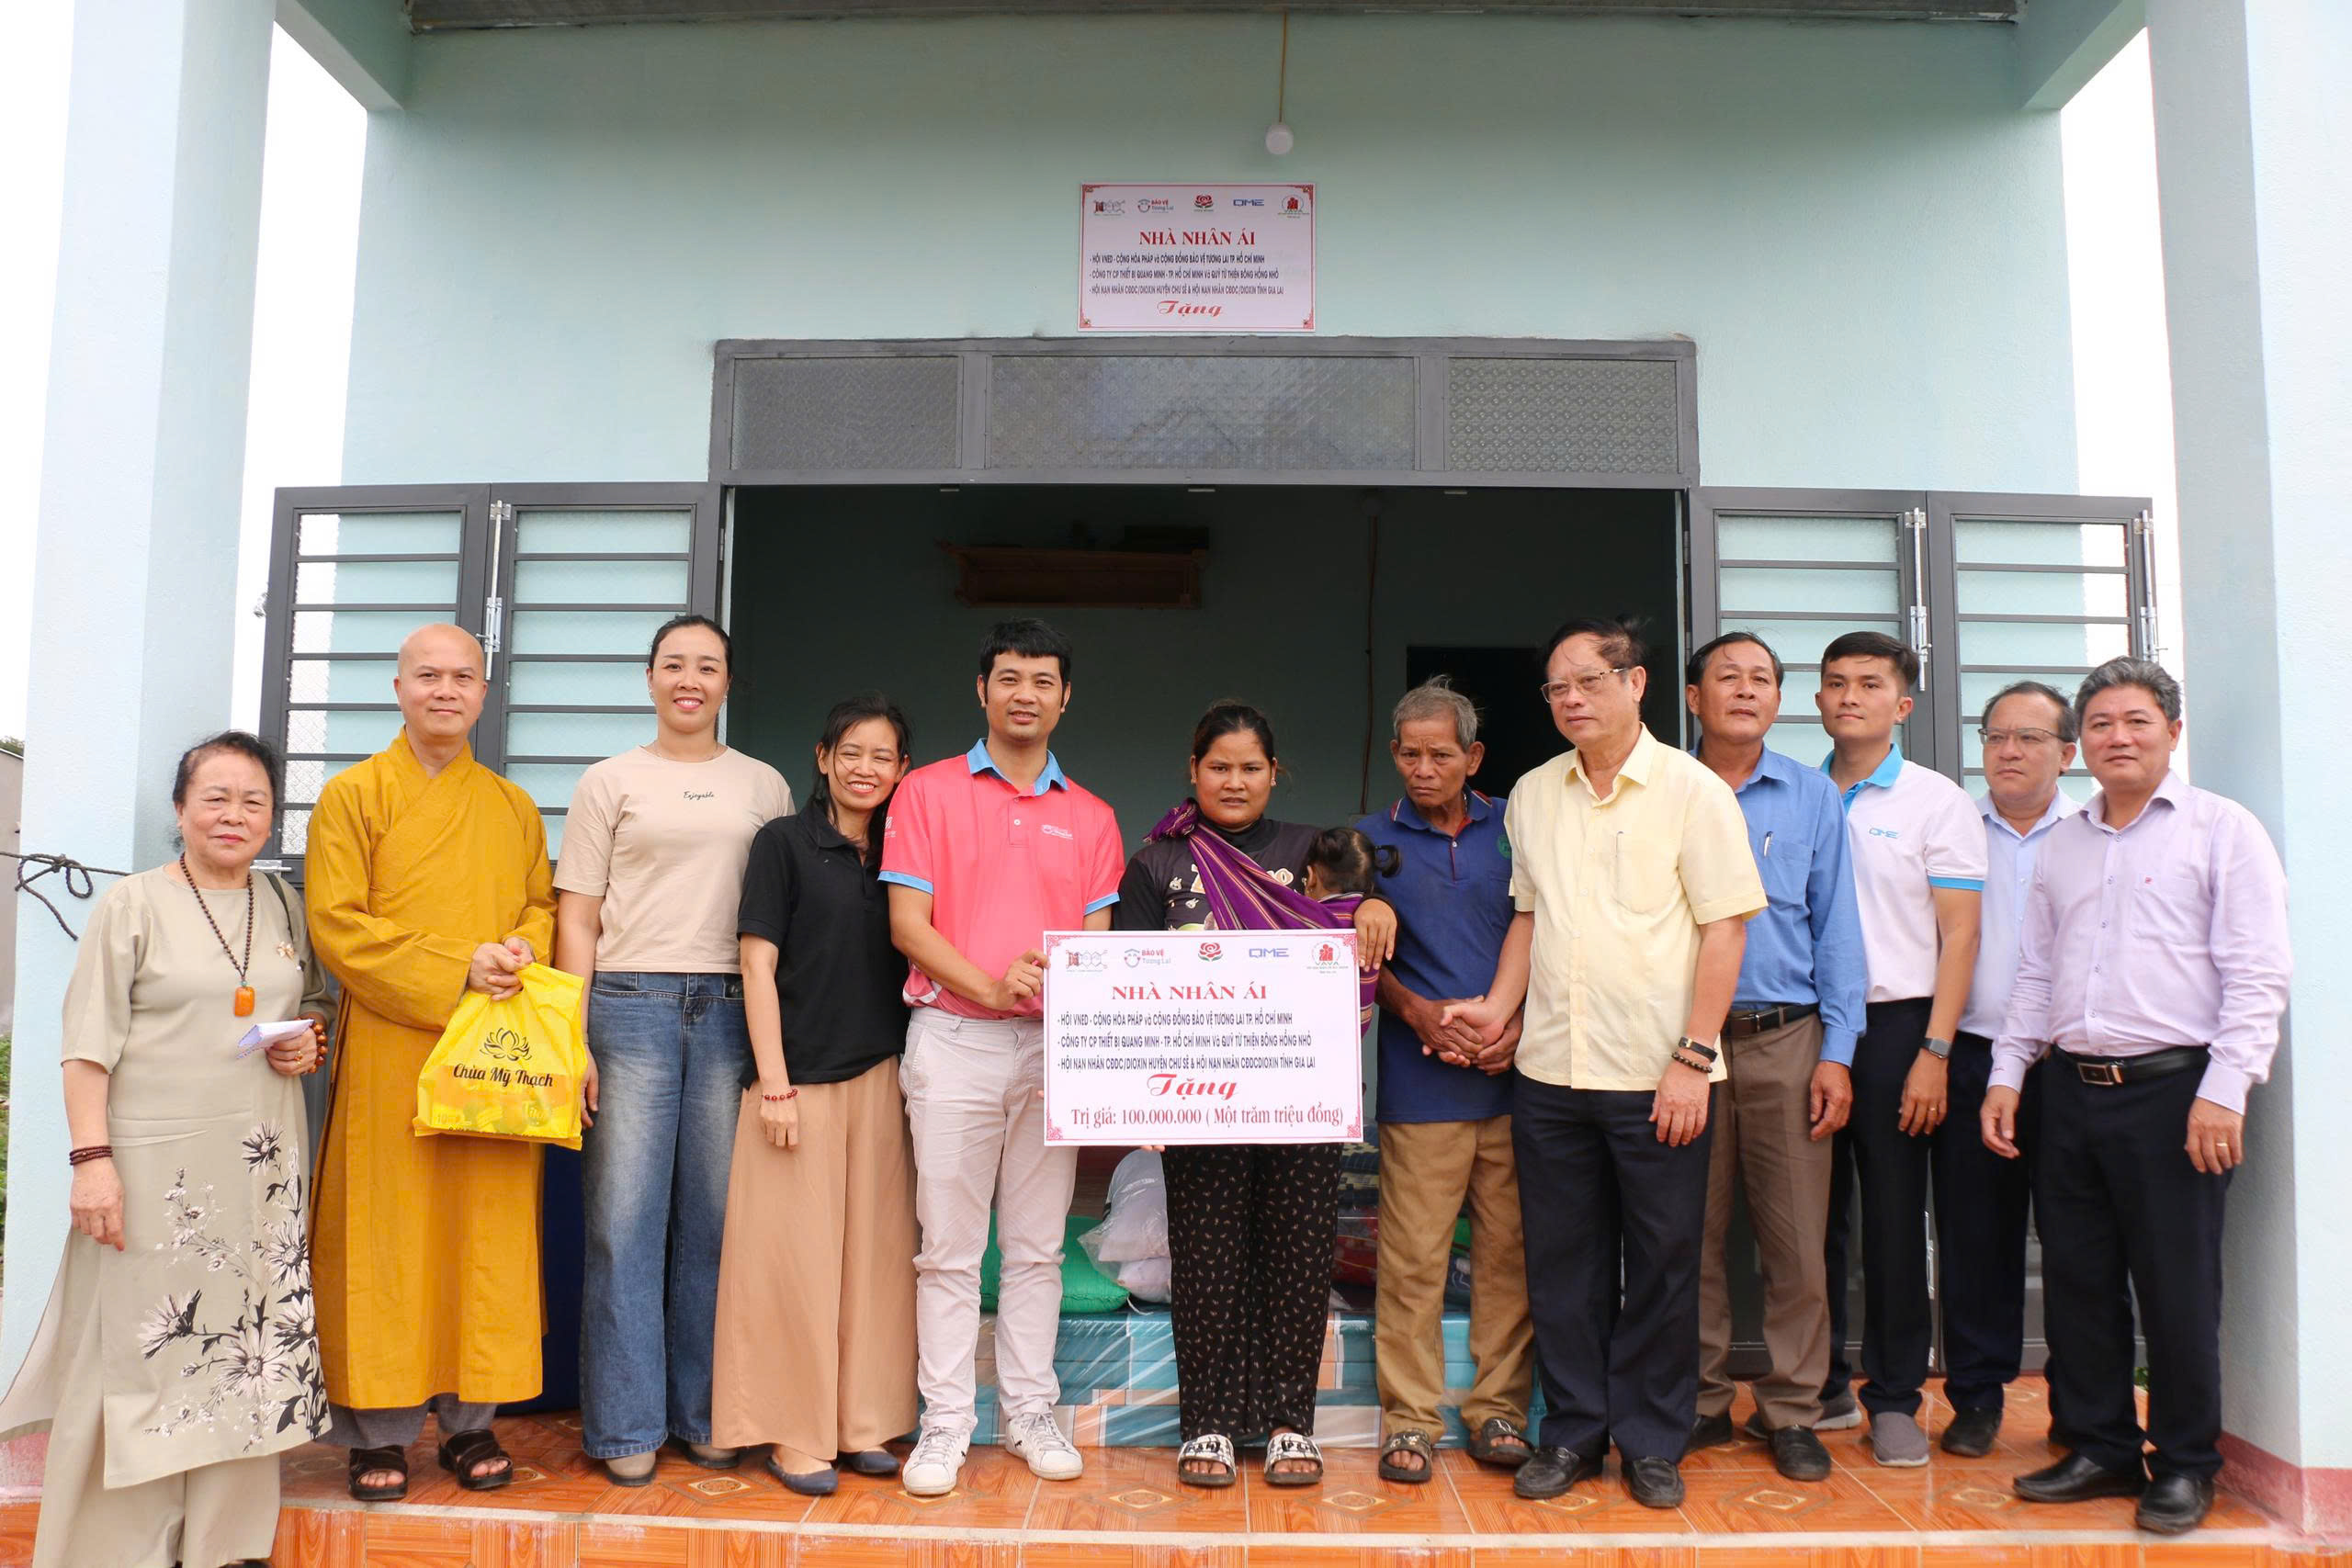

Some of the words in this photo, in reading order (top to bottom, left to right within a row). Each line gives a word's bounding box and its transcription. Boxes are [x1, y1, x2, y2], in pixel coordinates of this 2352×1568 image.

[1139, 228, 1176, 244] NHÀ
[1182, 228, 1231, 244] NHÂN
[1238, 228, 1255, 244] ÁI
[1157, 300, 1222, 317] Tặng
[1249, 948, 1289, 958] QME
[1112, 982, 1161, 999] NHÀ
[1170, 981, 1235, 999] NHÂN
[1243, 981, 1266, 999] ÁI
[1061, 1010, 1071, 1029] HỘI
[1073, 1013, 1089, 1025] VNED
[1093, 1010, 1112, 1029] CỘNG
[1113, 1010, 1125, 1025] HÒA
[1127, 1010, 1143, 1025] PHÁP
[1145, 1013, 1152, 1025] và
[1153, 1010, 1170, 1029] CỘNG
[1172, 1007, 1190, 1025] ĐỒNG
[1193, 1009, 1204, 1025] BẢO
[1205, 1010, 1213, 1029] VỆ
[1215, 1012, 1234, 1025] TƯƠNG
[1236, 1013, 1245, 1025] LAI
[1255, 1007, 1263, 1025] HỒ
[1265, 1010, 1276, 1025] CHÍ
[1277, 1013, 1293, 1025] MINH
[1061, 1032, 1080, 1047] CÔNG
[1080, 1035, 1088, 1047] TY
[1089, 1035, 1097, 1047] CP
[1099, 1031, 1113, 1047] THIẾT
[1114, 1036, 1120, 1051] BỊ
[1122, 1035, 1143, 1047] QUANG
[1144, 1035, 1159, 1047] MINH
[1164, 1035, 1172, 1047] TP.
[1173, 1029, 1182, 1047] HỒ
[1183, 1032, 1194, 1047] CHÍ
[1195, 1035, 1211, 1047] MINH
[1213, 1034, 1220, 1047] Và
[1222, 1032, 1234, 1047] QUỸ
[1236, 1032, 1242, 1046] TỪ
[1244, 1032, 1260, 1050] THIỆN
[1261, 1032, 1278, 1046] BÔNG
[1280, 1029, 1296, 1046] HỒNG
[1298, 1030, 1311, 1046] NHỎ
[1061, 1055, 1071, 1073] HỘI
[1073, 1058, 1086, 1073] NẠN
[1088, 1055, 1104, 1069] NHÂN
[1105, 1058, 1148, 1070] CĐDC/DIOXIN
[1148, 1055, 1167, 1073] HUYỆN
[1169, 1057, 1182, 1069] CHƯ
[1182, 1055, 1190, 1069] SÊ
[1191, 1058, 1194, 1069] &
[1196, 1055, 1207, 1073] HỘI
[1209, 1057, 1221, 1073] NẠN
[1223, 1055, 1239, 1068] NHÂN
[1241, 1057, 1278, 1068] CĐDCDIOXIN
[1280, 1053, 1294, 1068] TỈNH
[1295, 1056, 1305, 1068] GIA
[1306, 1056, 1316, 1068] LAI
[454, 1063, 485, 1080] Chùa
[490, 1066, 512, 1087] Mỹ
[515, 1068, 553, 1088] Thạch
[1147, 1073, 1238, 1100] Tặng
[1071, 1108, 1090, 1129] Trị
[1093, 1107, 1116, 1129] giá:
[1123, 1109, 1202, 1124] 100.000.000
[1214, 1105, 1237, 1128] Một
[1241, 1107, 1270, 1123] trăm
[1274, 1104, 1303, 1127] triệu
[1307, 1101, 1343, 1127] đồng)
